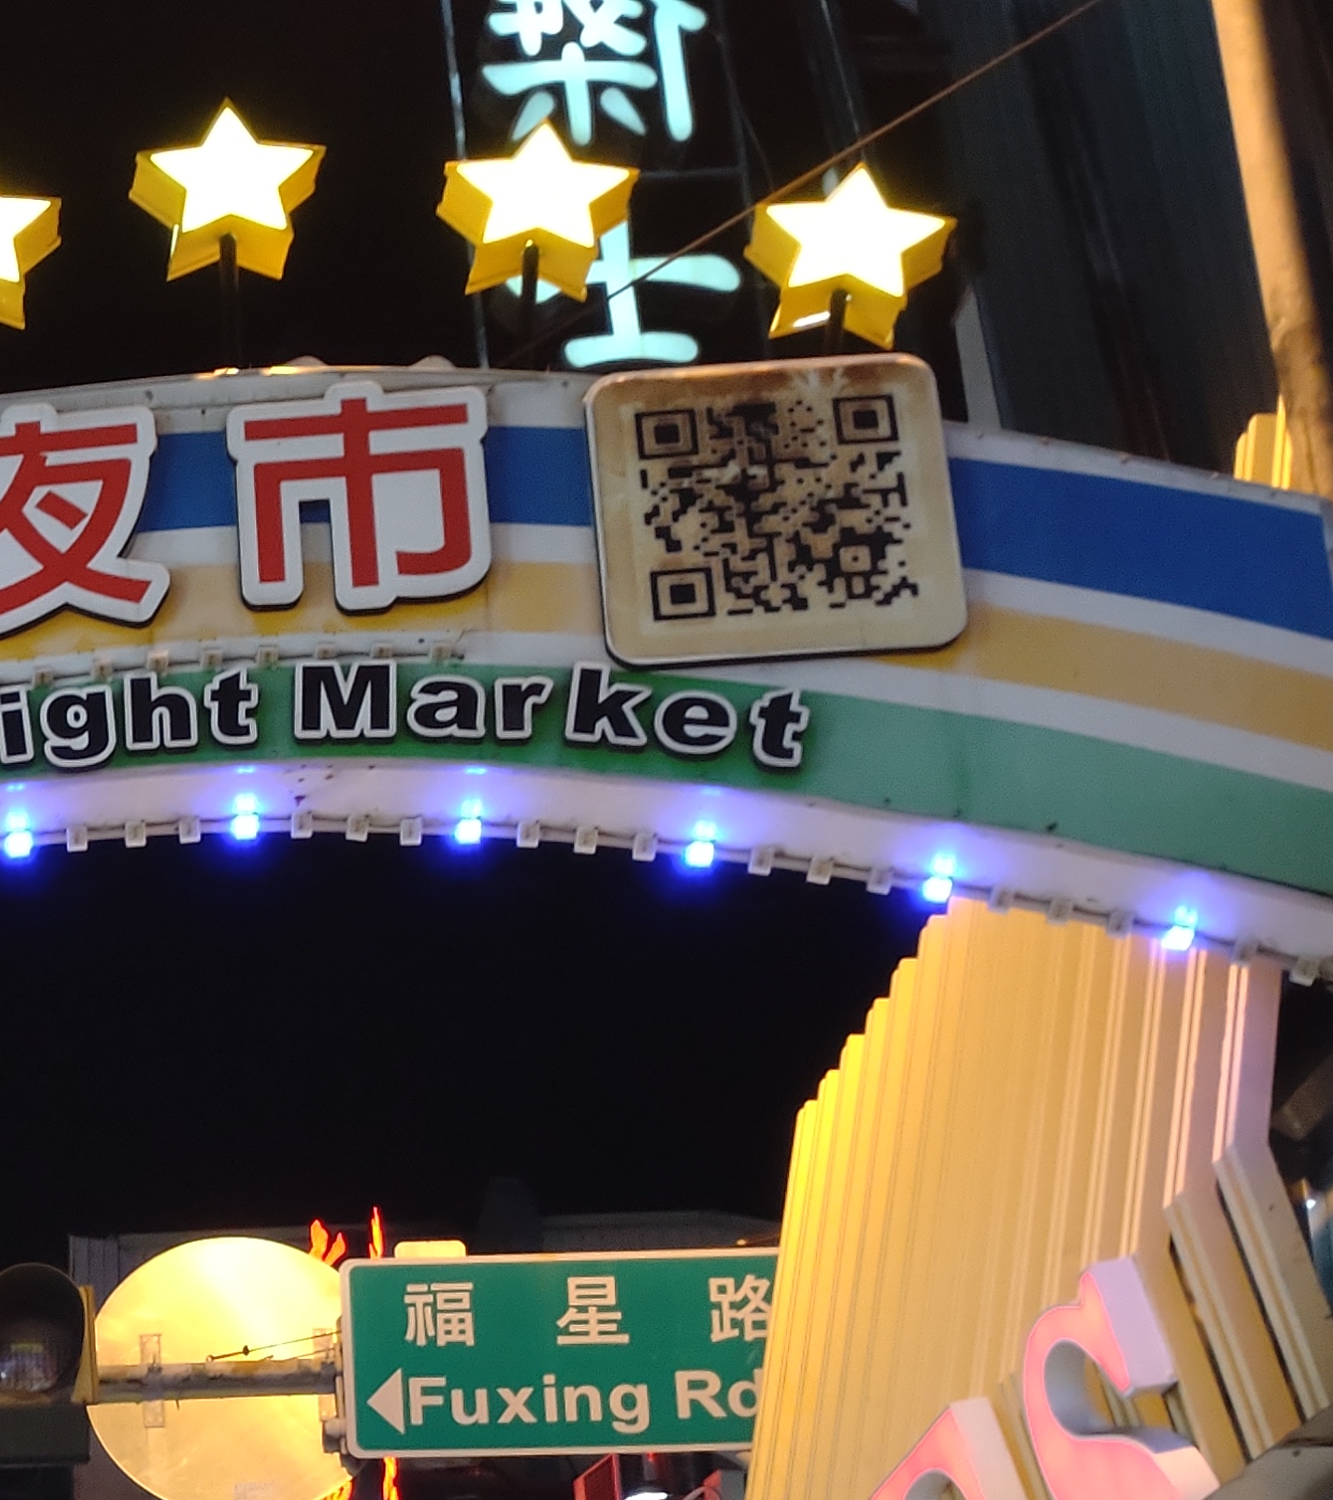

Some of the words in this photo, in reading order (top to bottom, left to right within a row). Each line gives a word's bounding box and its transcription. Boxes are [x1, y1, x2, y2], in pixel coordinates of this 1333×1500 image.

[292, 658, 811, 769] Market
[403, 1274, 770, 1349] 福星路
[408, 1373, 651, 1434] Fuxing
